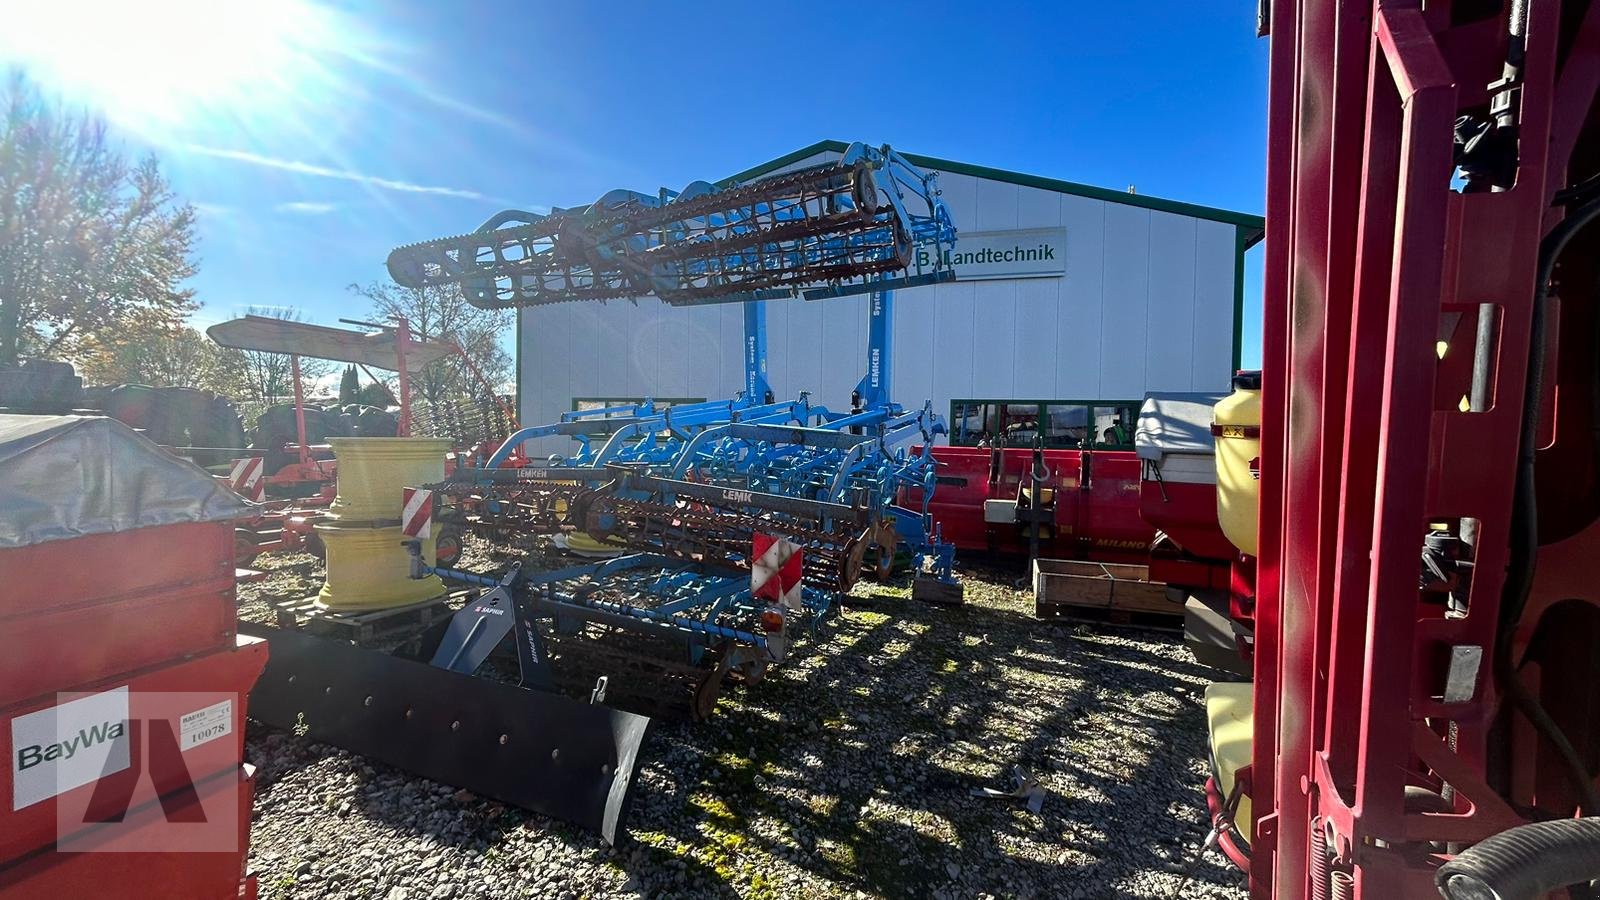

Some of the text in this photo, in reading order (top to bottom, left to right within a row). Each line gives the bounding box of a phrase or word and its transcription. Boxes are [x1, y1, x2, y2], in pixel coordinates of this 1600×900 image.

[944, 244, 1055, 266] Landtechnik
[872, 349, 880, 388] LEMKEN
[517, 469, 548, 478] LEMKEN
[1096, 538, 1146, 550] MILANO
[527, 629, 540, 665] SAPHIR
[192, 723, 225, 743] 10078
[18, 721, 125, 772] BayWa
